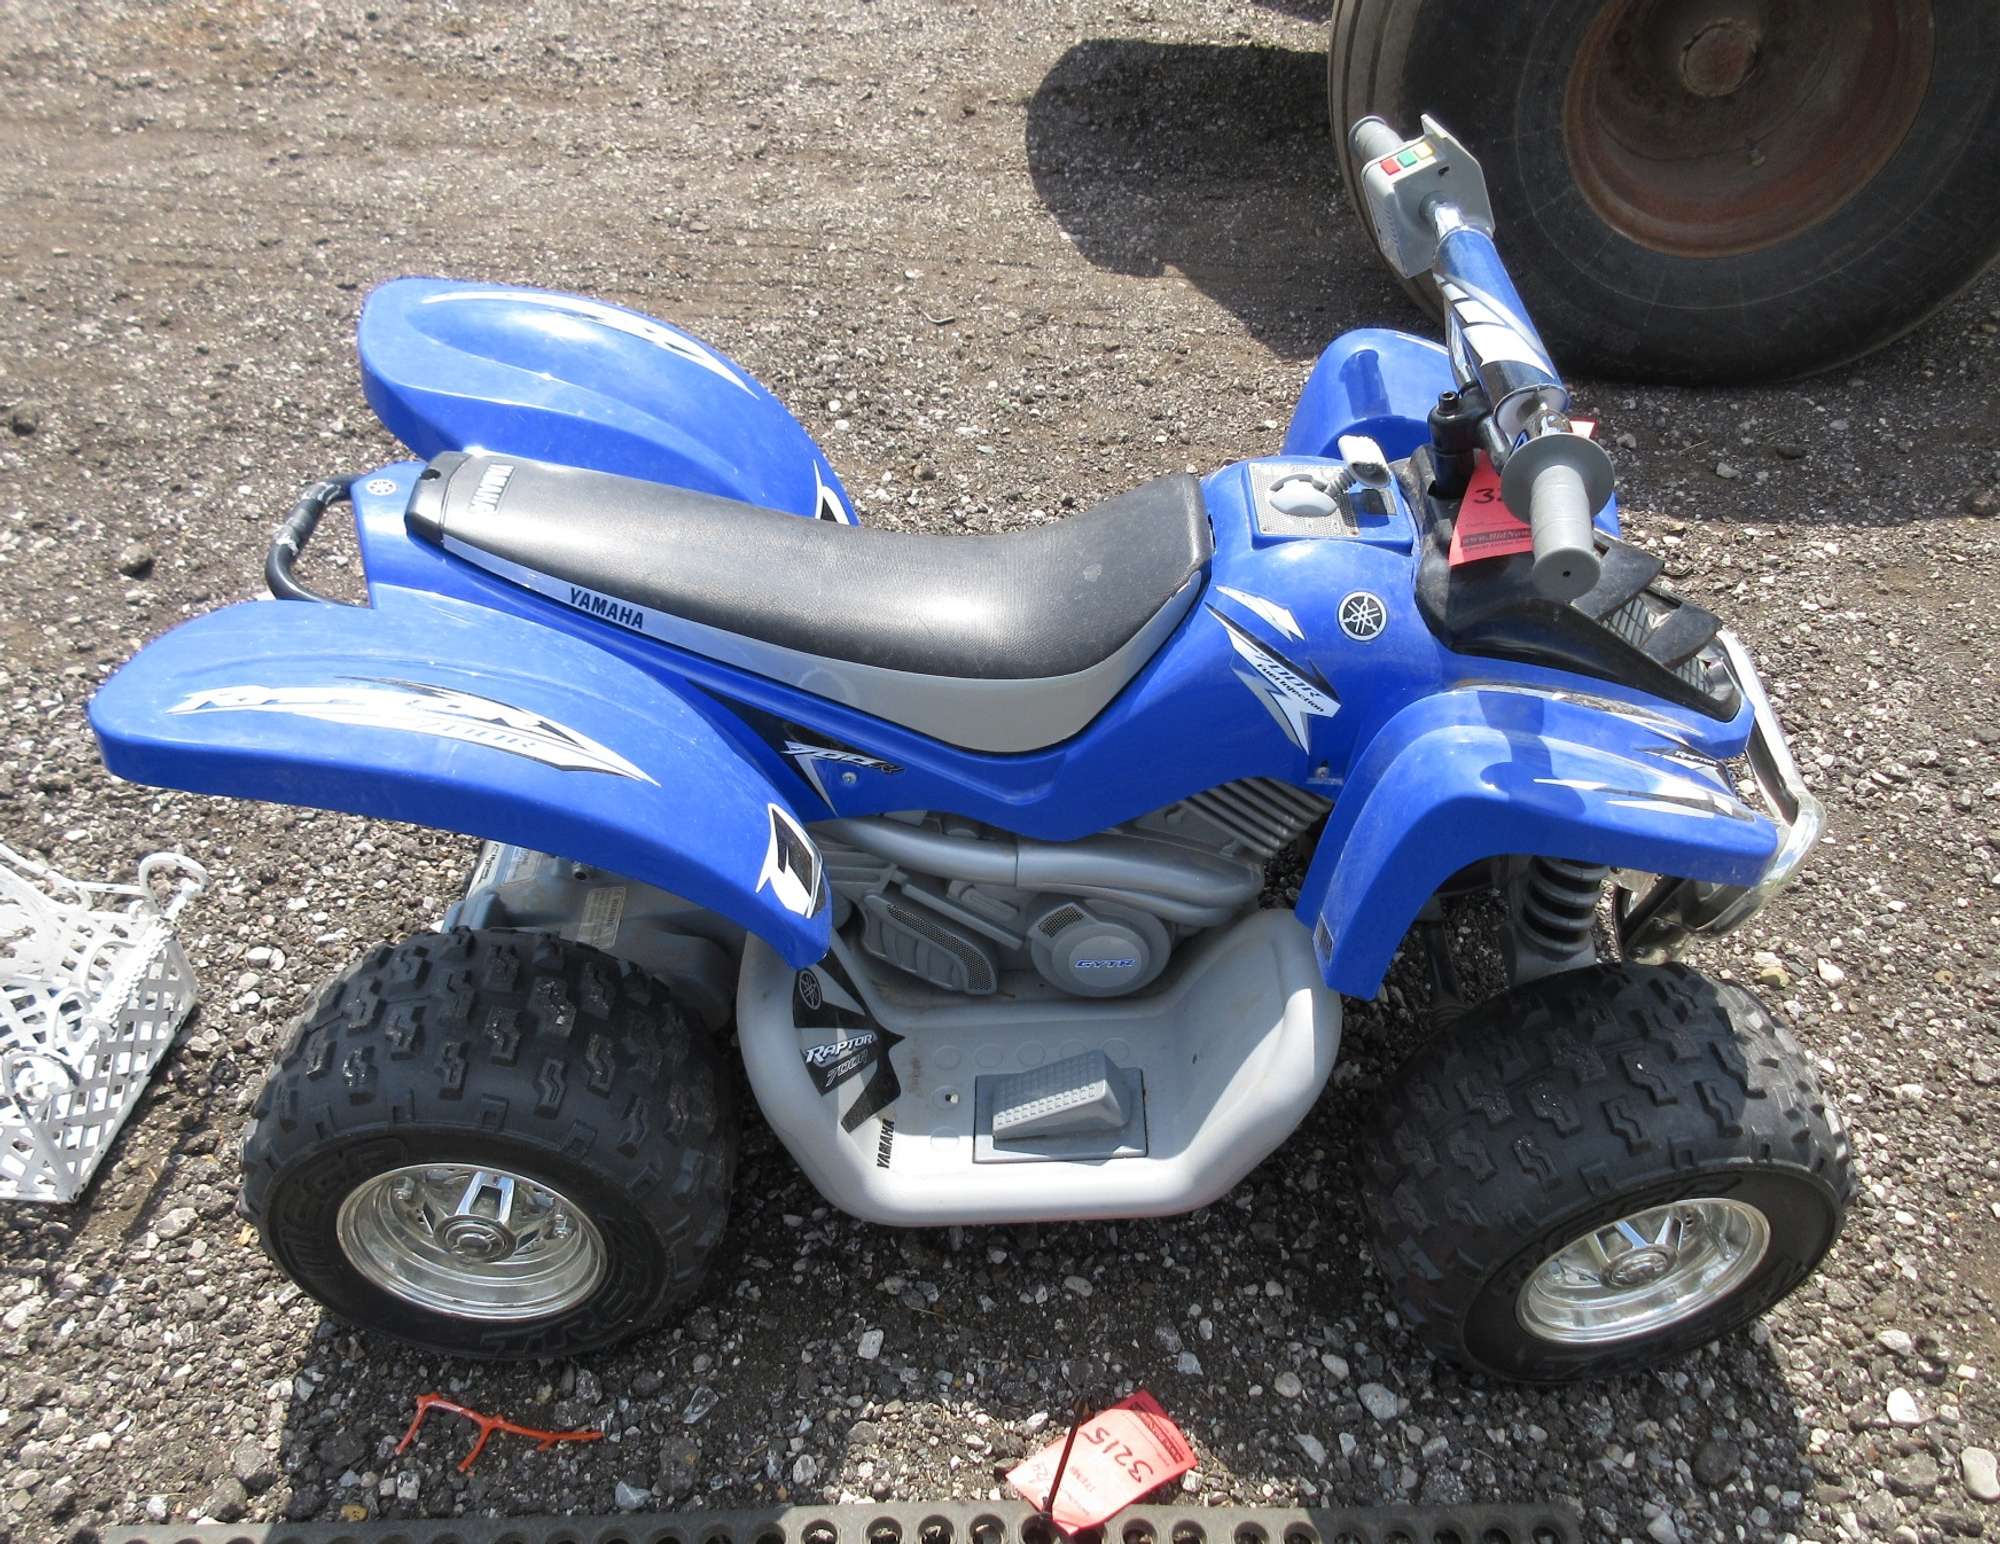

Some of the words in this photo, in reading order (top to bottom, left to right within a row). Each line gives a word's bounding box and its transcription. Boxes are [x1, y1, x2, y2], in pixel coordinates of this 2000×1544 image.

[1473, 487, 1502, 504] 3
[570, 588, 644, 629] YAMAHA
[806, 1034, 873, 1063] RAPTOR
[877, 1118, 895, 1169] YAMAHA
[1078, 1426, 1154, 1484] 3215
